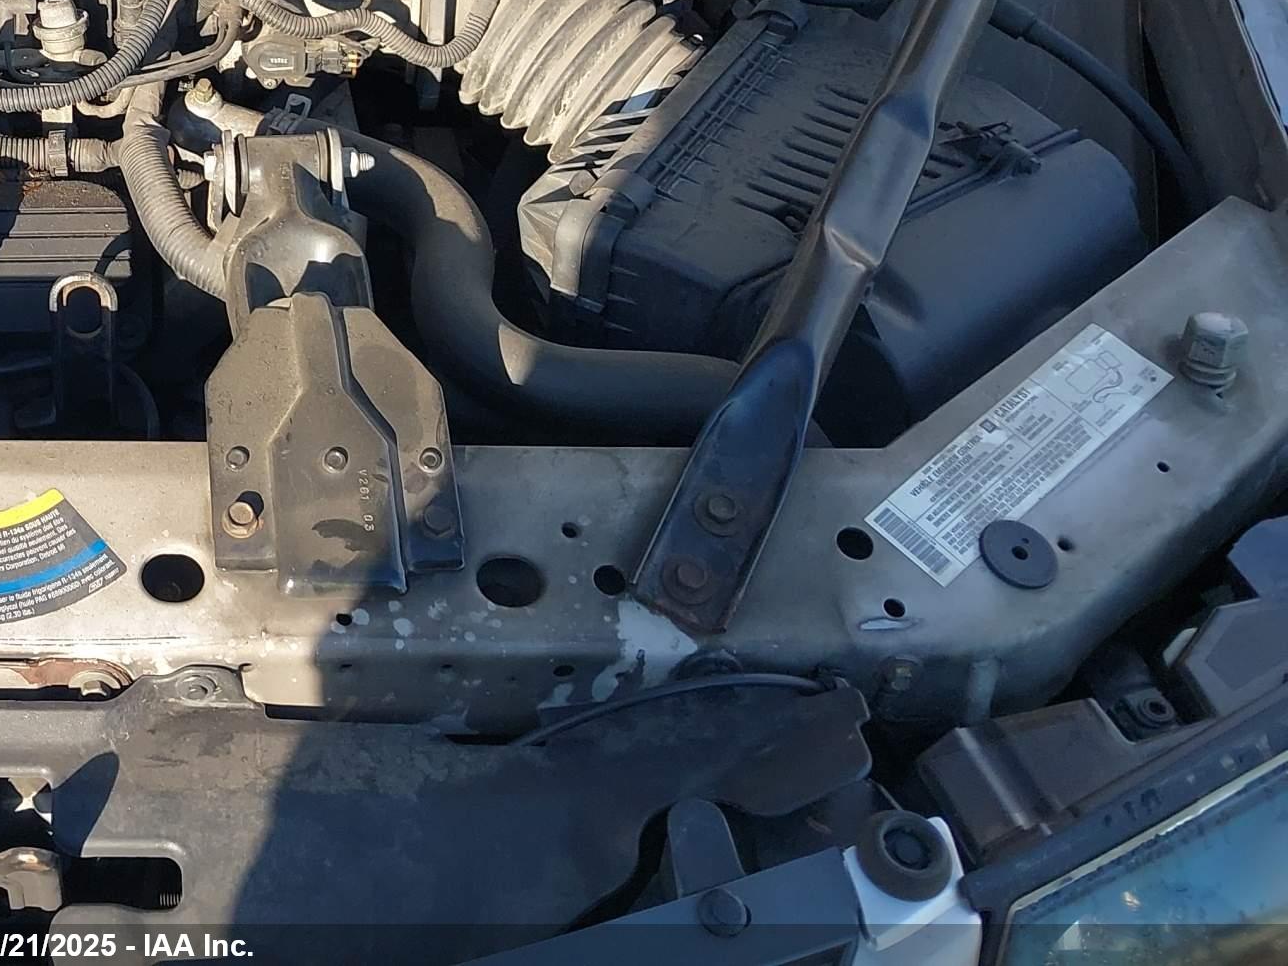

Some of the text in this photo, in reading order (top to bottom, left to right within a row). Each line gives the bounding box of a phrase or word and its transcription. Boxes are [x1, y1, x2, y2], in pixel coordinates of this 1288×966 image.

[993, 387, 1032, 417] CATALYST
[909, 434, 982, 496] VEHICLE EMISSION CONTROL
[935, 454, 973, 486] INFORMATION
[359, 469, 369, 500] V261
[3, 527, 25, 539] R-134a
[25, 520, 41, 531] SOUS
[41, 509, 60, 524] HAUTE
[42, 523, 53, 532] doit
[53, 517, 64, 526] être
[57, 525, 68, 533] Des
[26, 543, 48, 556] peuvent
[48, 535, 66, 547] causer
[66, 528, 76, 538] des
[15, 590, 32, 600] fluide
[61, 572, 82, 584] R-134a
[81, 553, 108, 574] seulement
[35, 594, 48, 604] PAG
[81, 574, 94, 586] avec
[5, 611, 22, 620] (2.30
